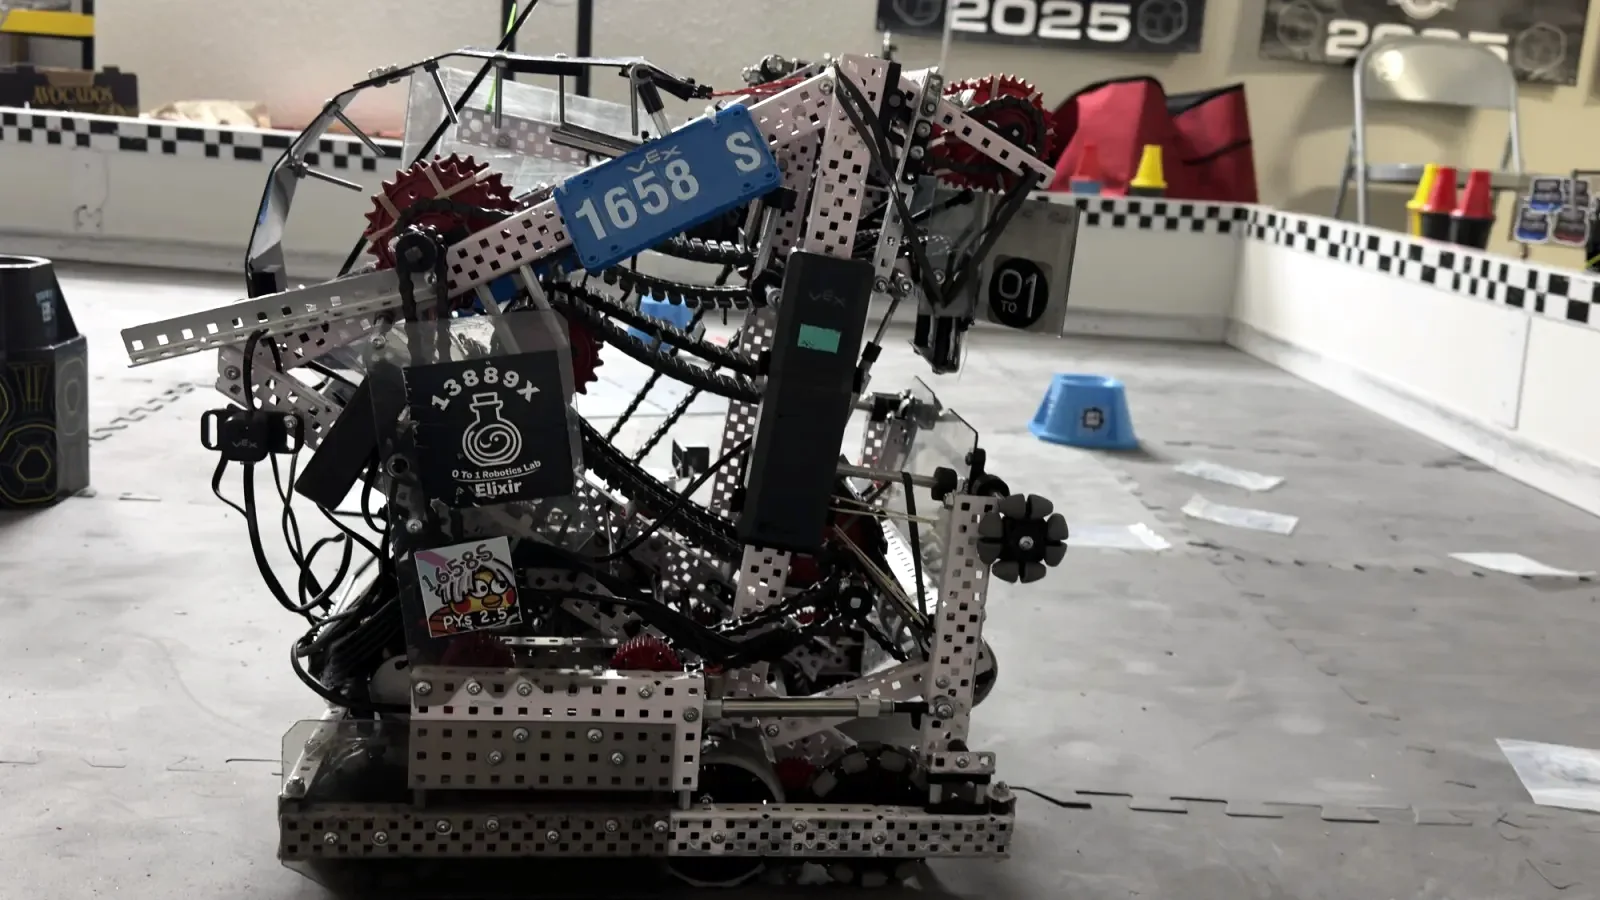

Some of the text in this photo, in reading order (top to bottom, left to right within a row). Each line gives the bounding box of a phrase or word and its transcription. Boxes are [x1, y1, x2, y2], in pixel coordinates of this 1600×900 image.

[950, 0, 1132, 42] 2025
[626, 144, 681, 173] VEX
[574, 130, 762, 241] 1658 S
[808, 289, 846, 309] VEX
[431, 366, 541, 412] 13889X
[231, 438, 258, 449] VEX
[461, 470, 473, 480] To
[475, 471, 481, 479] 1
[482, 467, 523, 479] Robotics
[523, 459, 541, 472] Lab
[475, 479, 523, 497] Elixir
[421, 543, 494, 593] 1658S
[479, 607, 508, 624] 2.5
